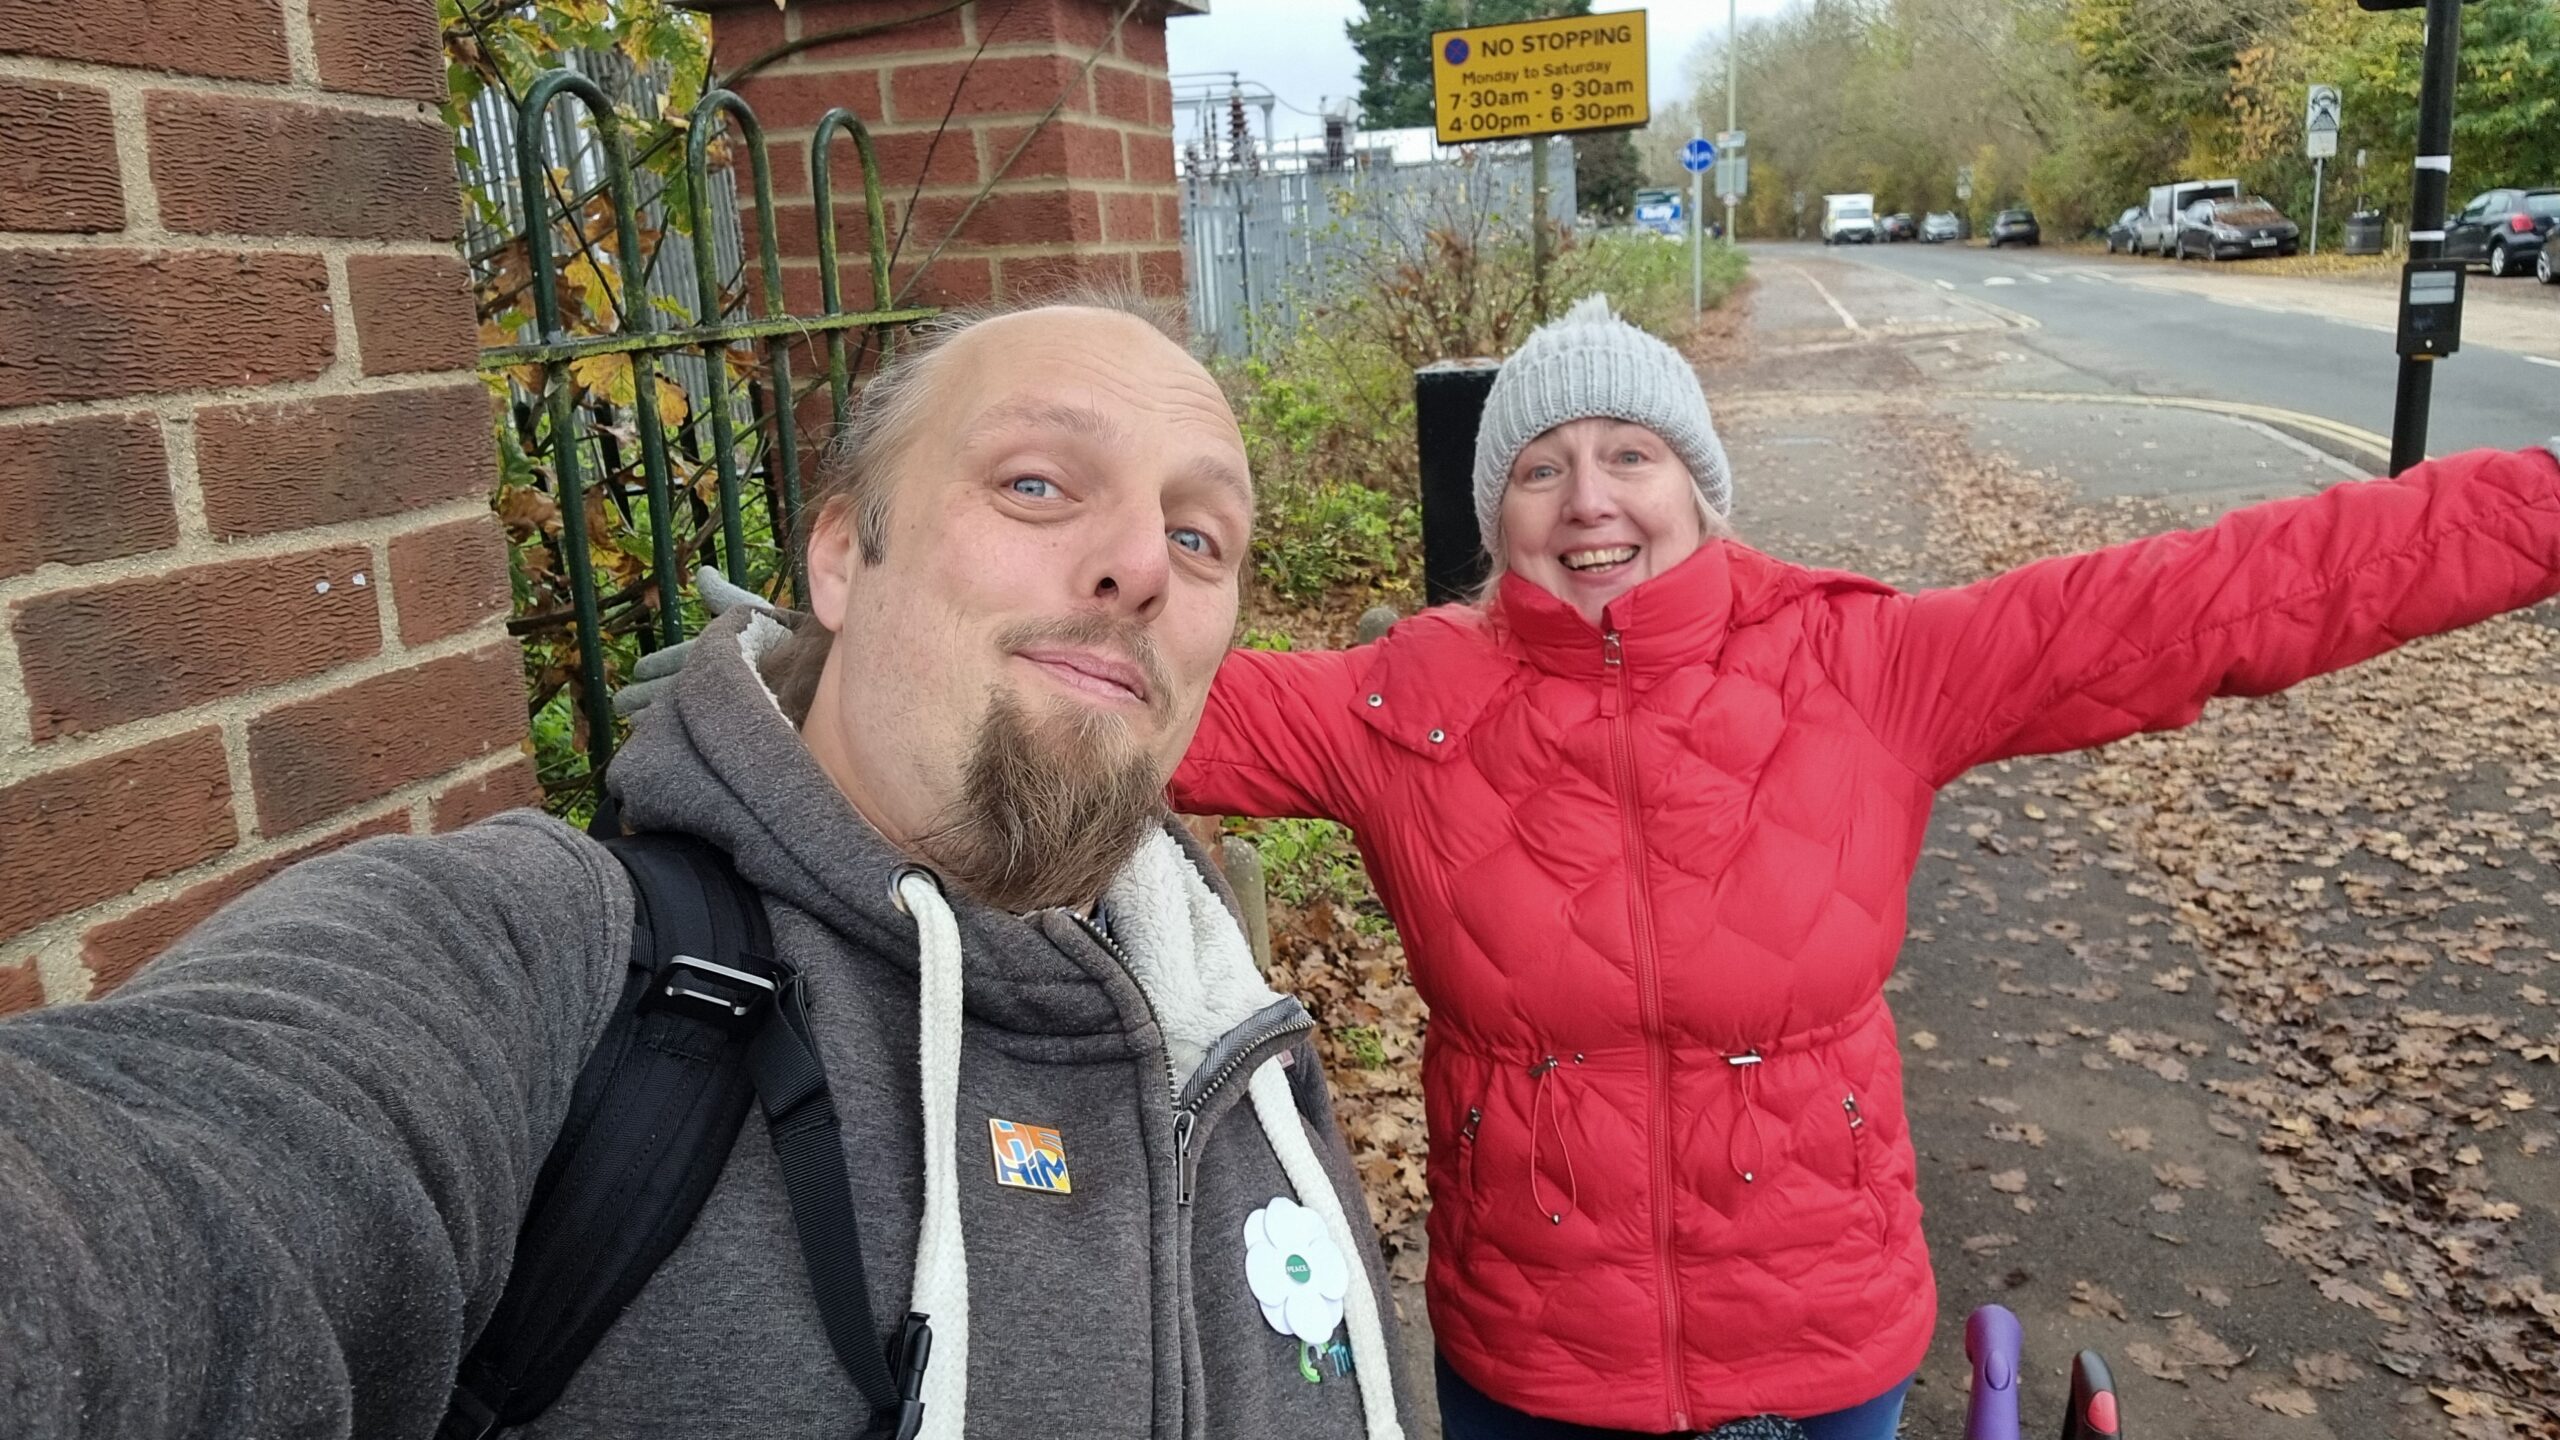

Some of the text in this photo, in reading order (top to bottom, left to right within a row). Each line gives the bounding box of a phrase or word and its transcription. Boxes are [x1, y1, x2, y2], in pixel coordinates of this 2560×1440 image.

[1481, 25, 1632, 58] NO STOPPING
[1462, 60, 1612, 85] Monday to Saturday
[993, 1120, 1064, 1163] HE
[1286, 1264, 1308, 1273] PEACE
